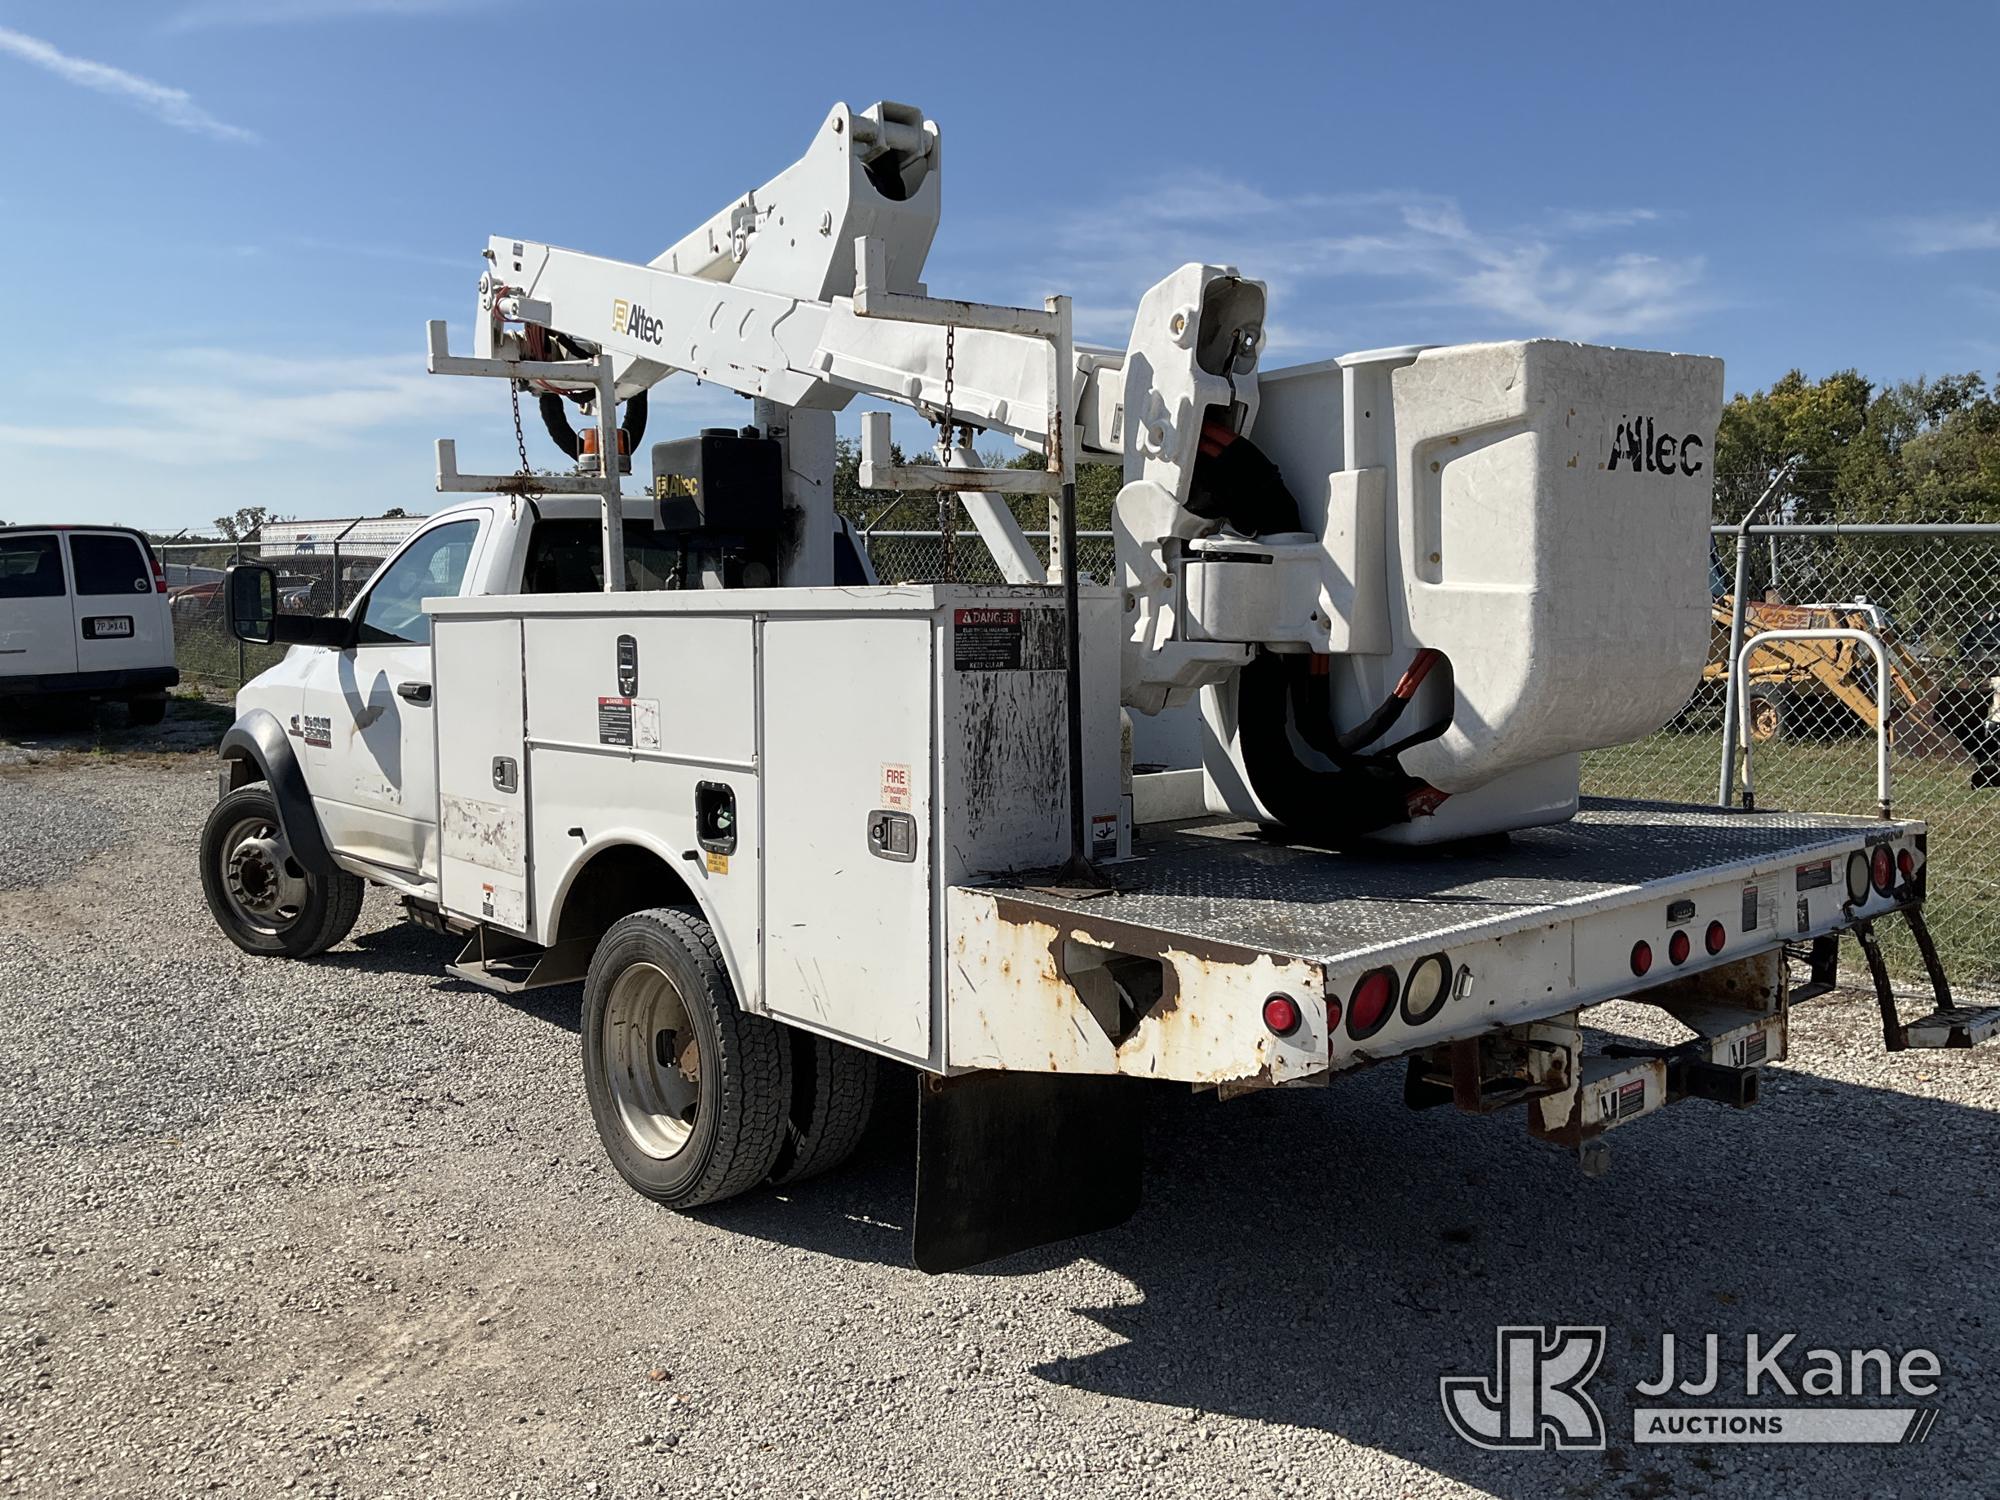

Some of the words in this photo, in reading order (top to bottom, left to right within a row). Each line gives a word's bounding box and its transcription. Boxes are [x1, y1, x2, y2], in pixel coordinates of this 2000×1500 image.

[627, 304, 663, 346] Altec
[1608, 414, 1703, 476] Altec
[973, 611, 1014, 623] DANGER
[886, 769, 905, 785] FIRE
